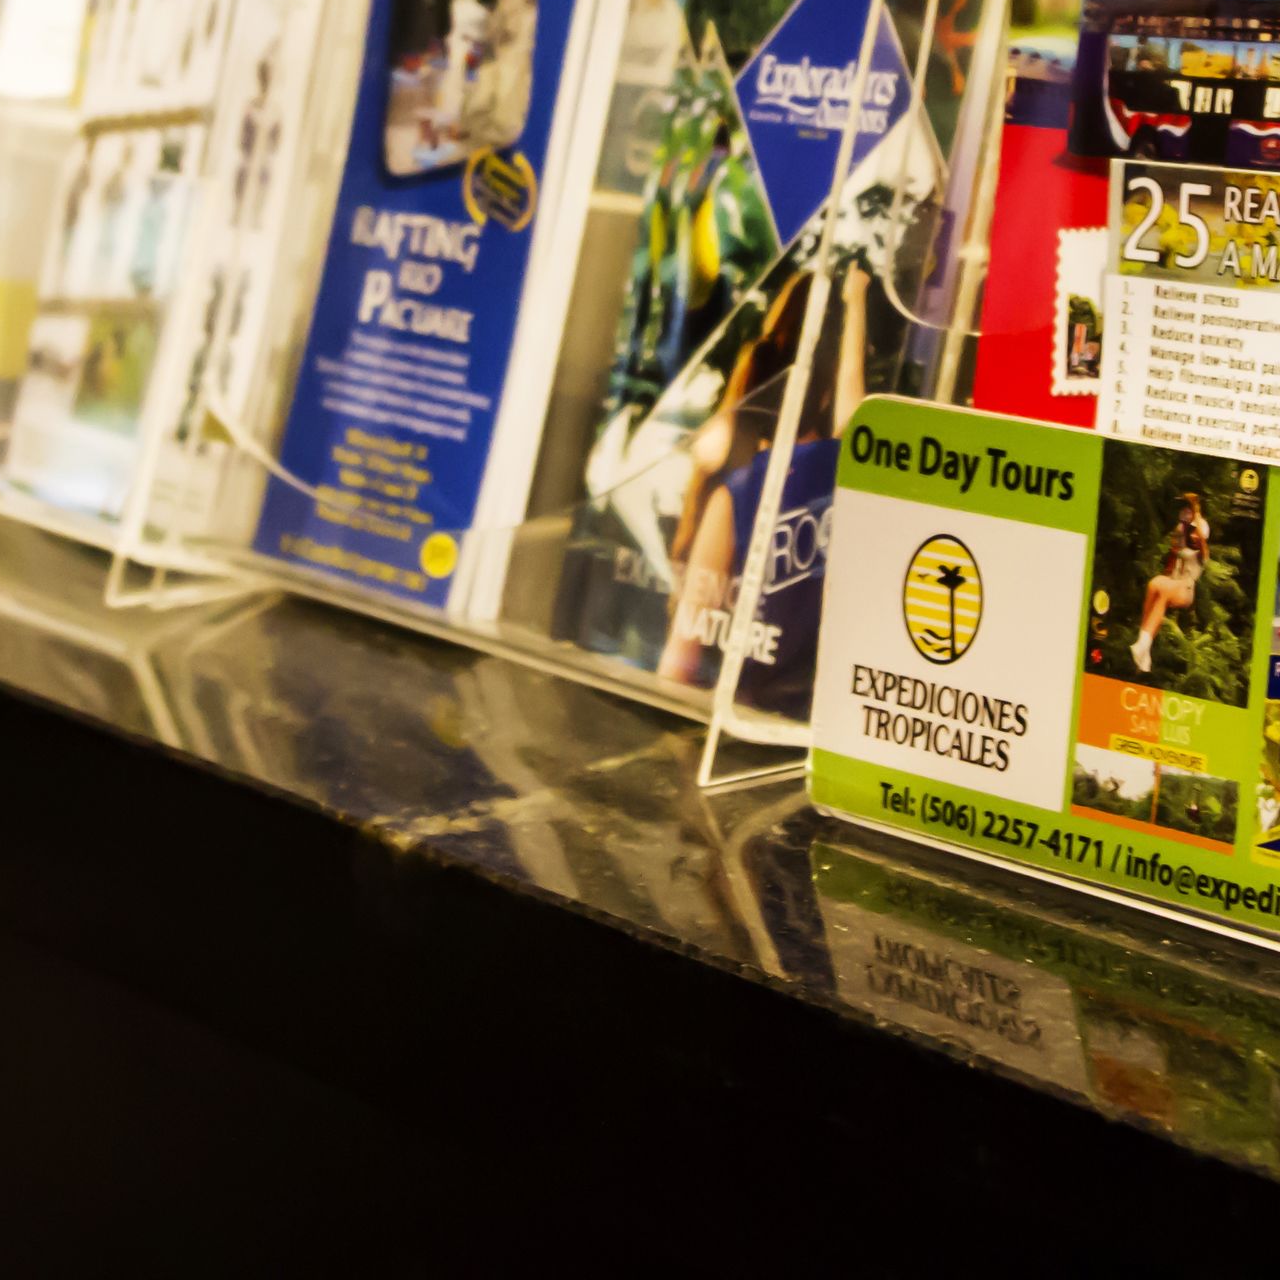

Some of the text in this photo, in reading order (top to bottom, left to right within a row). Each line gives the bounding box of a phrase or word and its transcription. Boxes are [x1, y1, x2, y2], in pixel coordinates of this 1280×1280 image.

[1123, 176, 1212, 269] 25
[1218, 240, 1241, 277] A
[1153, 305, 1196, 323] Relieve
[1154, 284, 1197, 303] Relieve
[1203, 293, 1239, 308] stress
[1151, 325, 1194, 344] Reduce
[1150, 346, 1195, 366] Manage
[1145, 384, 1188, 402] Reduce
[1140, 423, 1183, 443] Relieve
[850, 424, 1076, 502] One Day Tours
[850, 664, 1029, 737] EXPEDICIONES
[1121, 687, 1206, 725] CANOPY
[862, 704, 1010, 772] TROPICALES
[879, 781, 917, 817] Tel:
[920, 791, 978, 838] (506)
[982, 810, 1104, 869] 2257-4171
